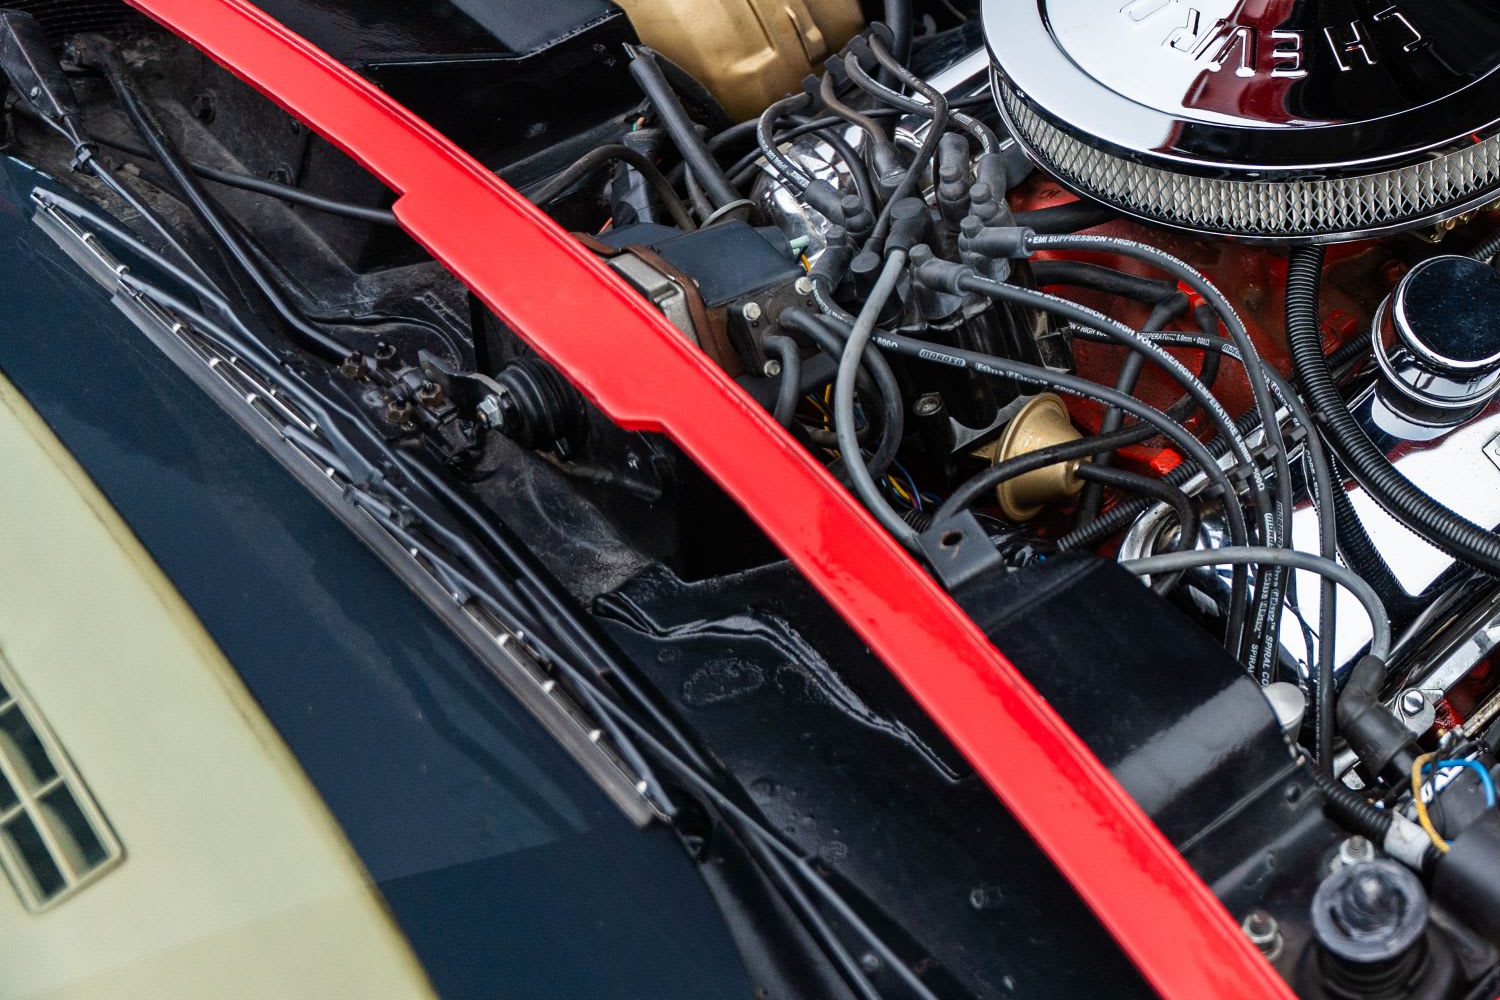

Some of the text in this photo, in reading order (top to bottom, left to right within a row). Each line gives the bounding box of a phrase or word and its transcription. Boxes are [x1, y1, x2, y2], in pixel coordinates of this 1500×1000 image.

[1033, 235, 1048, 244] EMI
[1048, 234, 1108, 243] SUPPRESSION
[1113, 237, 1138, 248] HIGH
[1138, 242, 1202, 278] VOLTAGE/HIGH
[1112, 320, 1137, 337] HIGH
[1136, 332, 1195, 382] VOLTAGE/HIGH
[1193, 377, 1239, 438] TEMPERATURE
[1235, 434, 1252, 464] 8.0mm
[1264, 634, 1274, 674] SPIRAL
